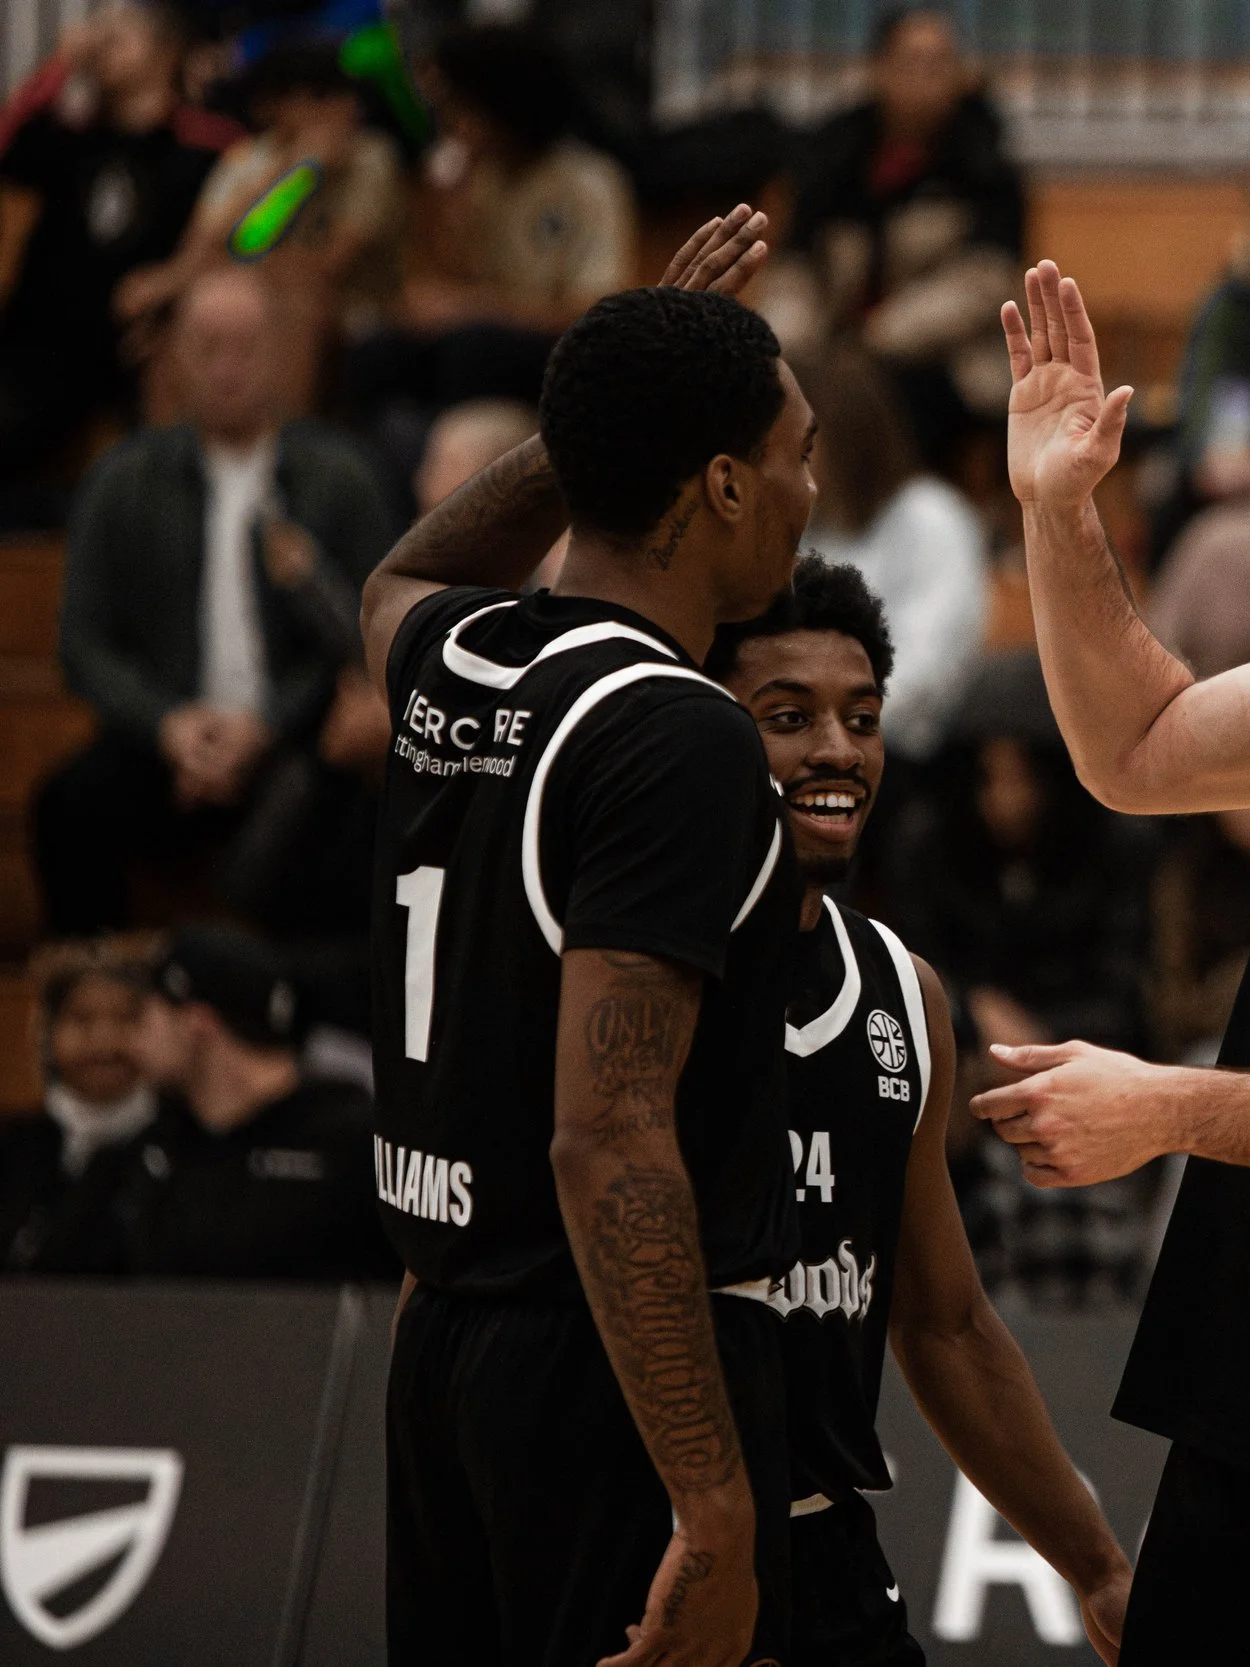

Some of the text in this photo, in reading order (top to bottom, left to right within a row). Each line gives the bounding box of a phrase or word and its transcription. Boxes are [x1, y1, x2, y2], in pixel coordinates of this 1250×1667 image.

[403, 689, 532, 750] ERCRE
[396, 866, 445, 1063] 1
[878, 1075, 910, 1101] BCB
[374, 1133, 472, 1227] ILLIAMS
[767, 1238, 876, 1322] oods
